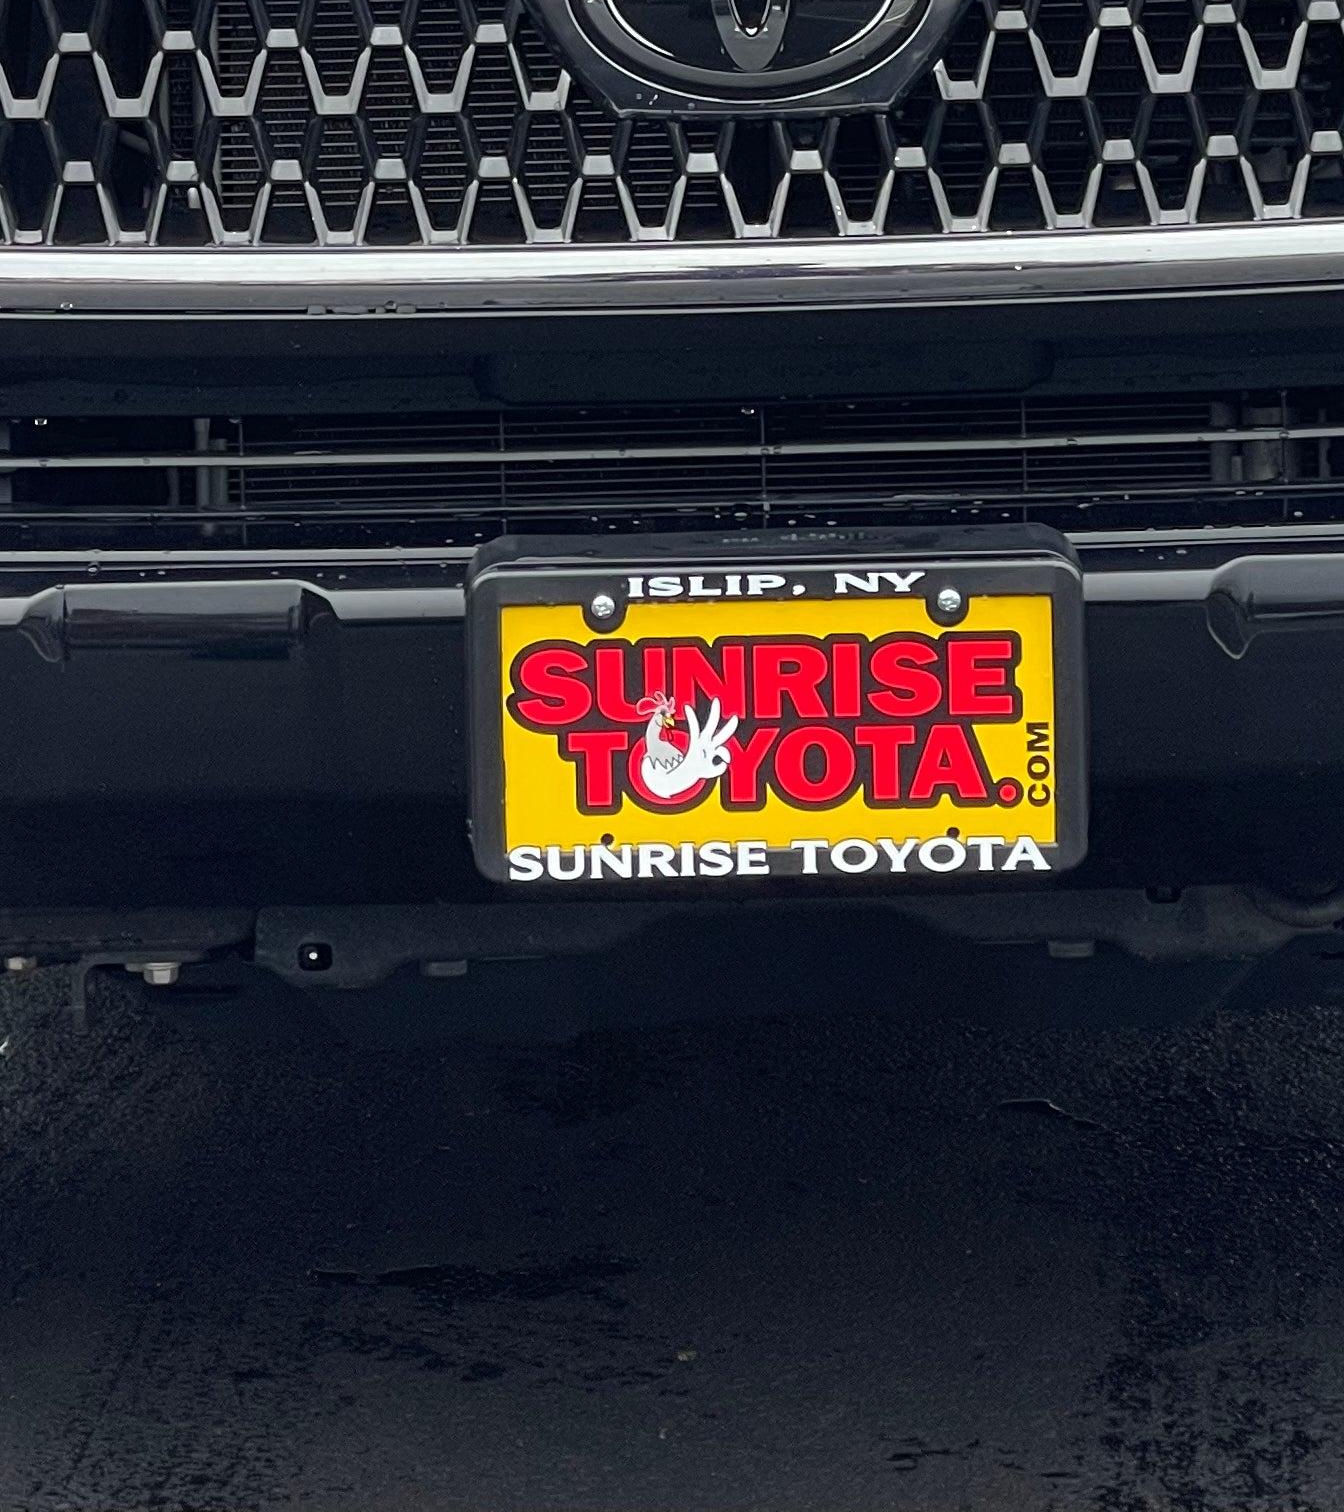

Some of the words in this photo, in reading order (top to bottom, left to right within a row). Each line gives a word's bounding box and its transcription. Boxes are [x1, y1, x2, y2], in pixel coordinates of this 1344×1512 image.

[627, 574, 806, 598] ISLIP,
[834, 571, 926, 594] NY
[517, 640, 1014, 725] SUNRISE
[508, 840, 770, 882] SUNRISE
[790, 836, 1052, 874] TOYOTA
